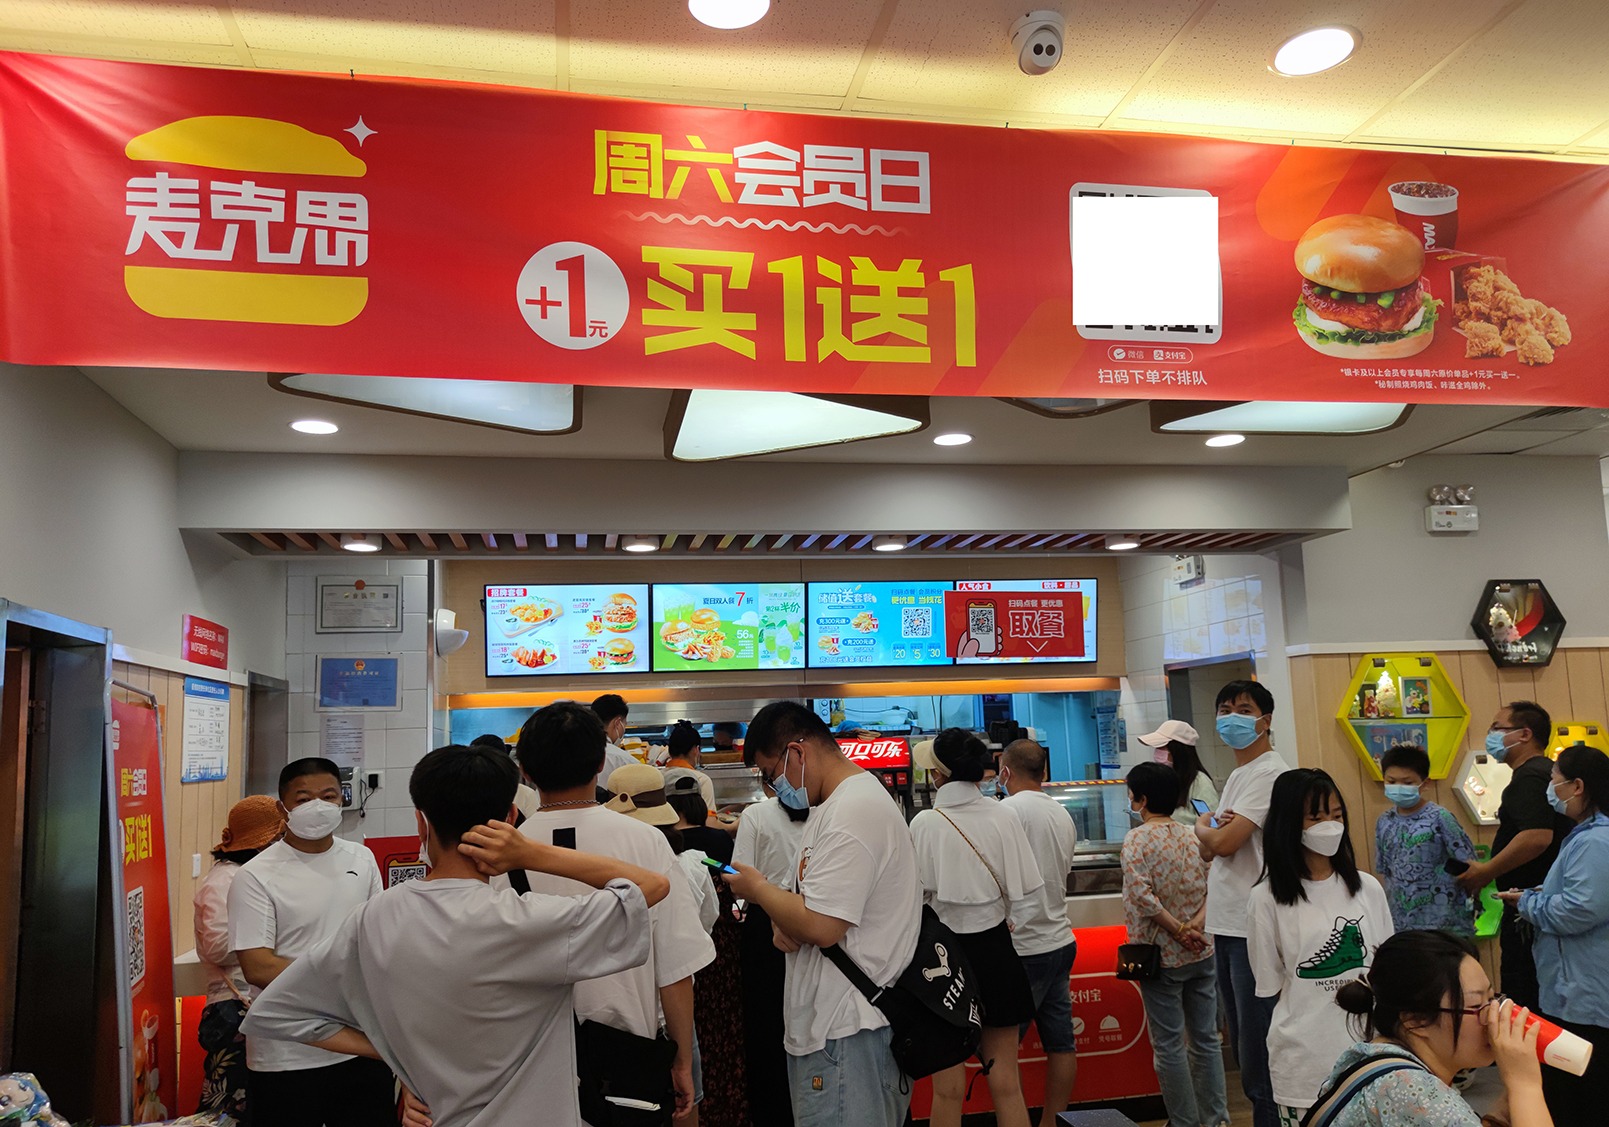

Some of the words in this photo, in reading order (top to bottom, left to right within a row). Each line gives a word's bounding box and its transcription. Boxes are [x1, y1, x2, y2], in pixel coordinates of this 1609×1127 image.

[593, 129, 931, 214] 周六会员日
[124, 171, 369, 267] 麦克思
[525, 254, 608, 338] +1元
[641, 245, 977, 368] 买1送1
[1127, 350, 1145, 360] 微信
[1164, 351, 1187, 361] 支付宝
[1097, 368, 1208, 386] 扫码下单不排队
[959, 582, 991, 590] 人气小食
[818, 588, 873, 605] 储值送套餐
[1008, 599, 1038, 608] 扫码点餐
[1041, 599, 1064, 608] 更优惠
[1008, 609, 1065, 638] 取餐
[840, 740, 905, 760] 可口可乐
[1069, 988, 1102, 1004] 支付宝
